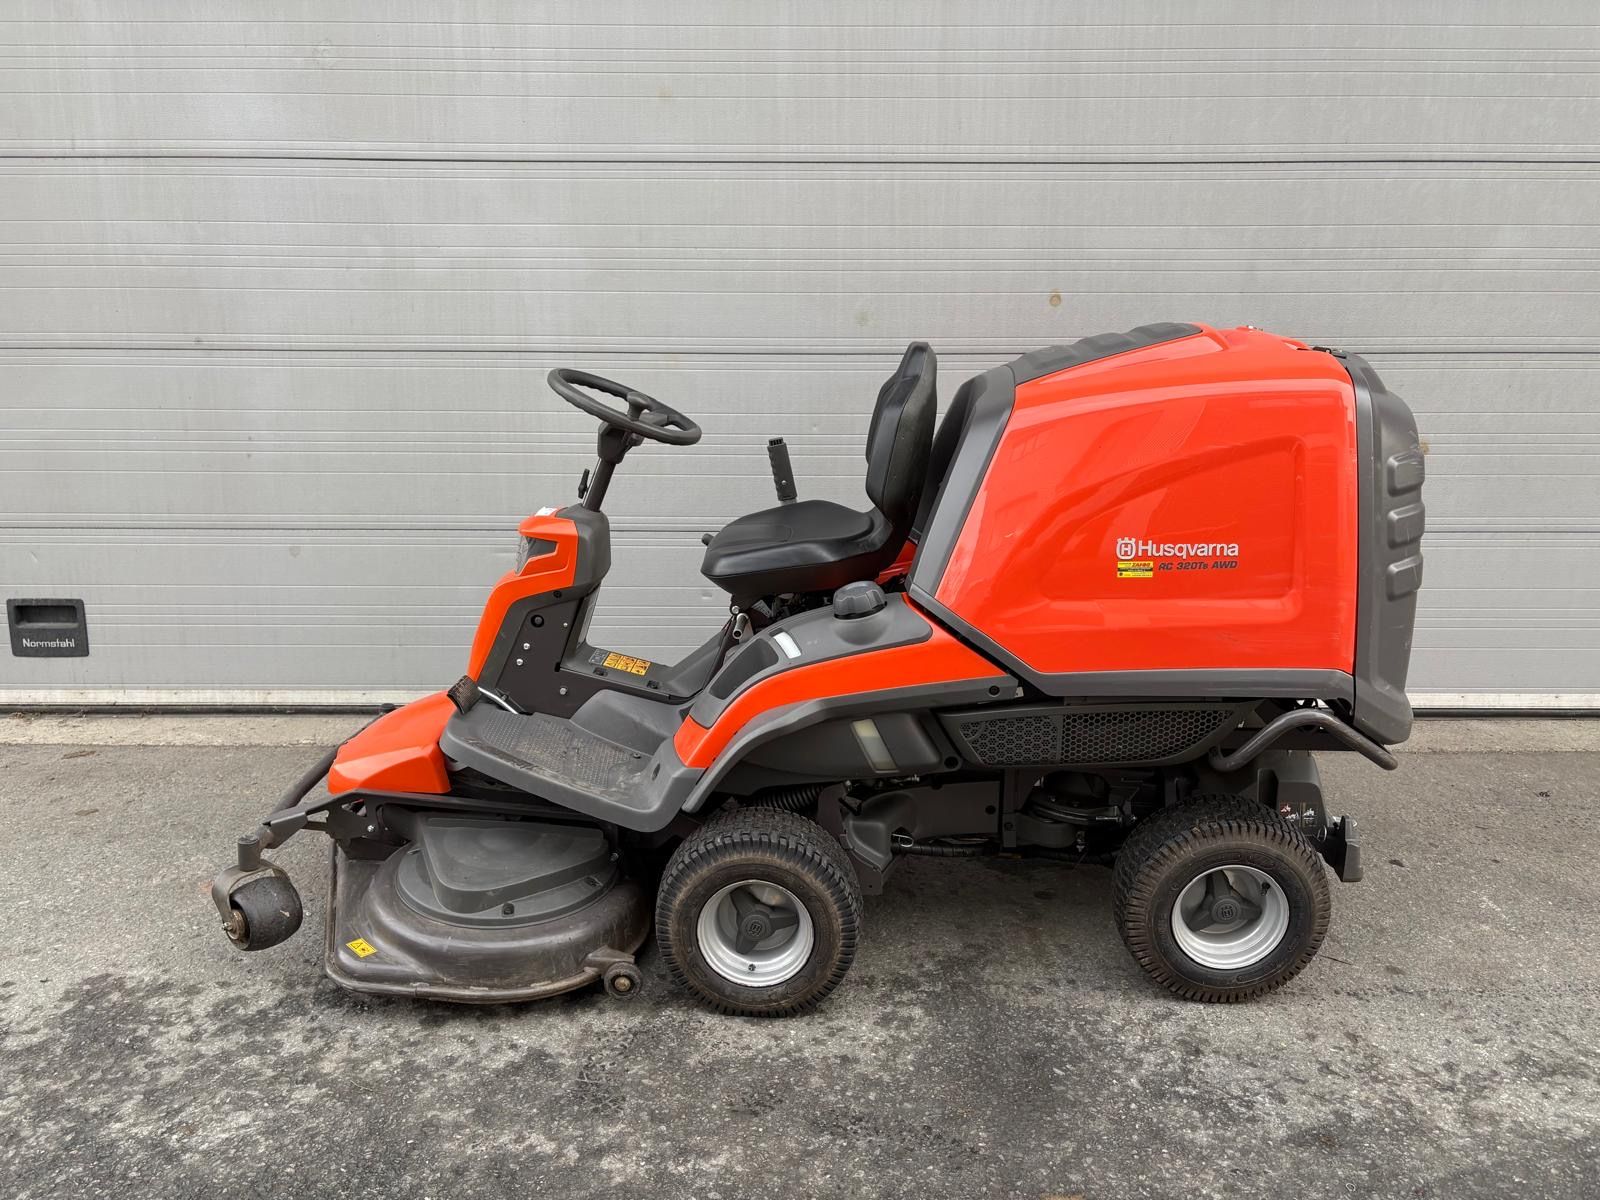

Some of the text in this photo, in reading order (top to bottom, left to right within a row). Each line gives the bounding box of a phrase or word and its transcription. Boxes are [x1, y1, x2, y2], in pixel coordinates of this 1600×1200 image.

[1138, 540, 1239, 559] Husqvarna
[1158, 562, 1174, 571] RC
[1211, 560, 1238, 569] AWD
[22, 638, 75, 648] Normstahl
